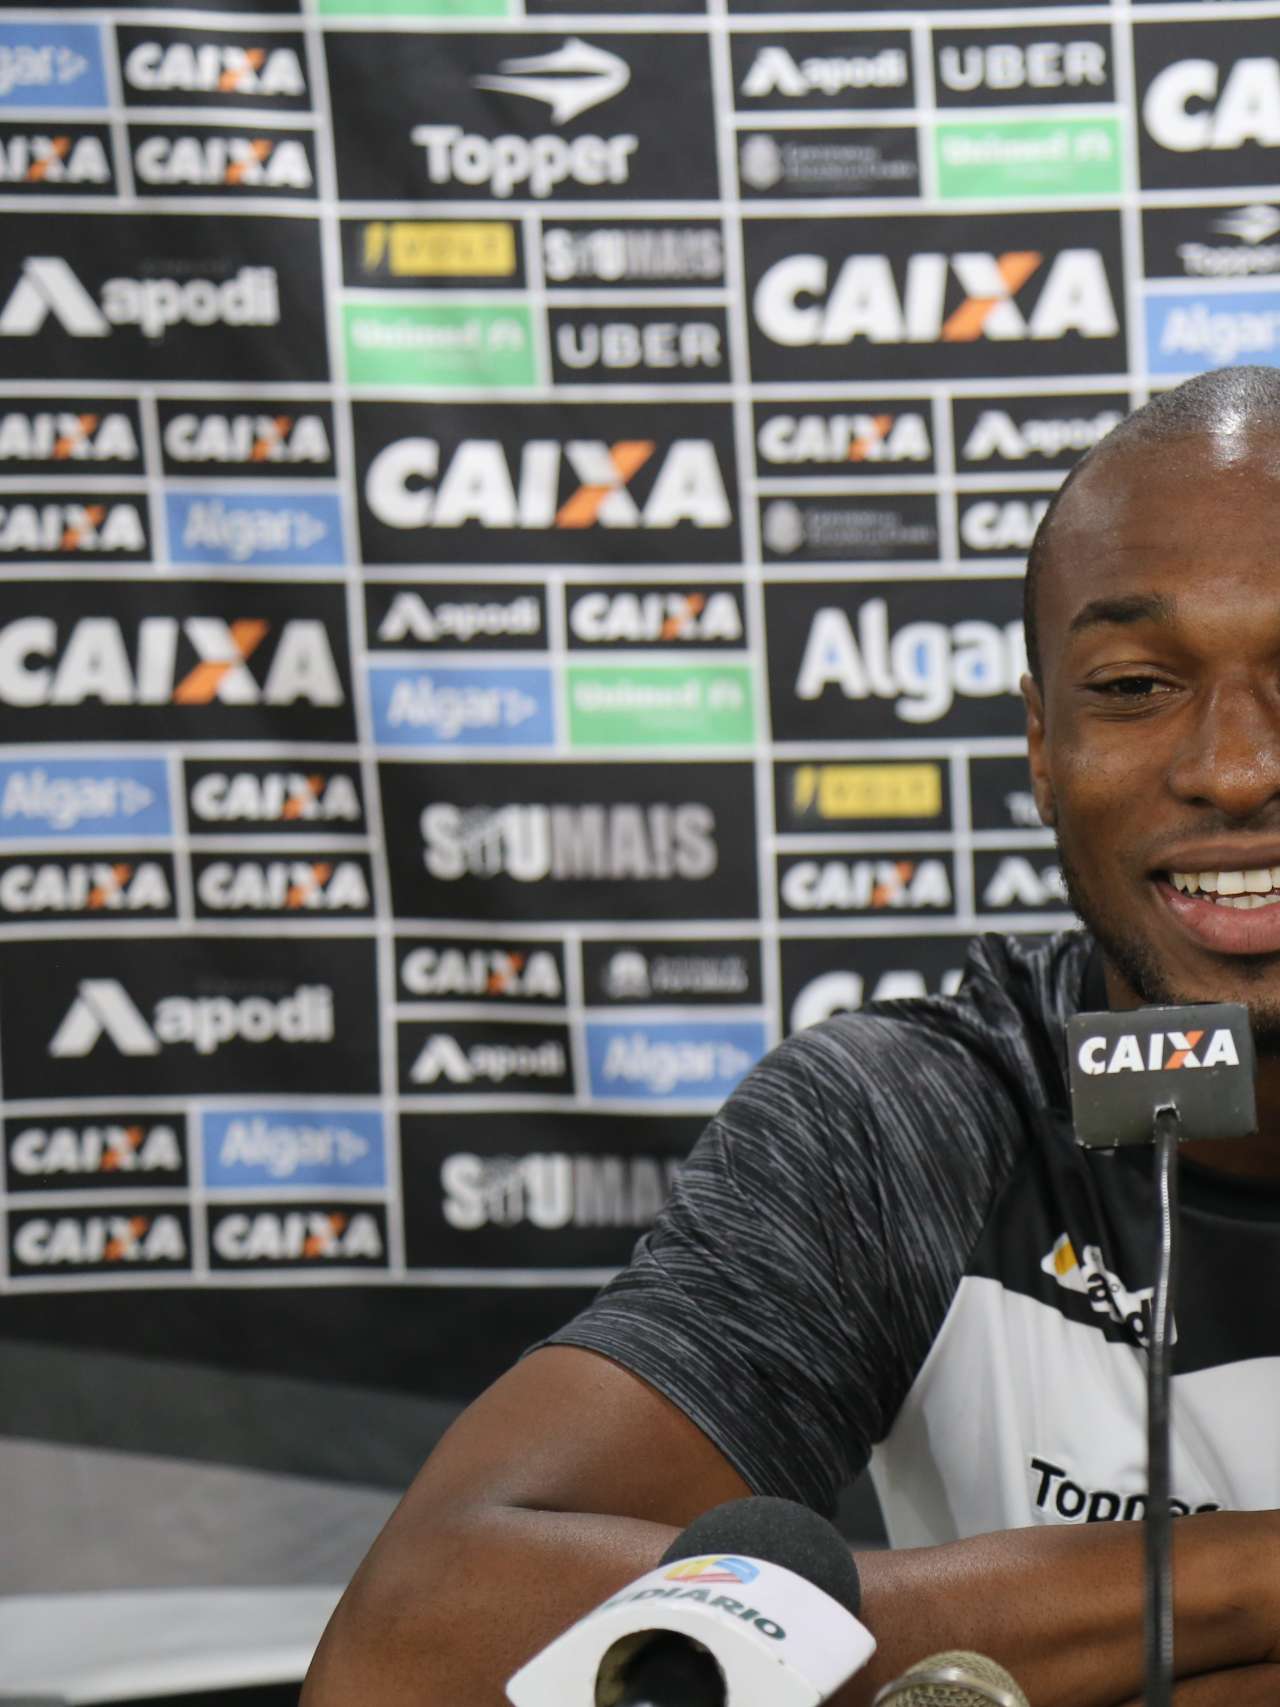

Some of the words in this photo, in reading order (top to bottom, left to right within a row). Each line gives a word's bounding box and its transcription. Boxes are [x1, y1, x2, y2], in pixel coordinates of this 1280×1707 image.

[126, 43, 304, 95] CAIXA
[940, 42, 1105, 90] UBER
[137, 138, 312, 188] CAIXA
[412, 125, 638, 198] Topper
[755, 249, 1117, 345] CAIXA
[558, 323, 719, 368] UBER
[1161, 303, 1275, 365] Algar
[164, 414, 331, 462] CAIXA
[759, 414, 930, 462] CAIXA
[366, 438, 730, 528] CAIXA
[183, 500, 292, 560] Algar
[571, 593, 741, 640] CAIXA
[0, 617, 342, 706] CAIXA
[388, 678, 503, 739] Algar
[0, 770, 118, 829] Algar
[192, 774, 358, 820] CAIXA
[0, 864, 169, 911] CAIXA
[199, 863, 368, 908] CAIXA
[782, 862, 952, 910] CAIXA
[402, 949, 560, 996] CAIXA
[603, 1032, 714, 1093] Algar
[1078, 1029, 1239, 1075] CAIXA
[11, 1127, 180, 1174] CAIXA
[219, 1117, 332, 1178] Algar
[15, 1216, 184, 1264] CAIXA
[214, 1213, 380, 1259] CAIXA
